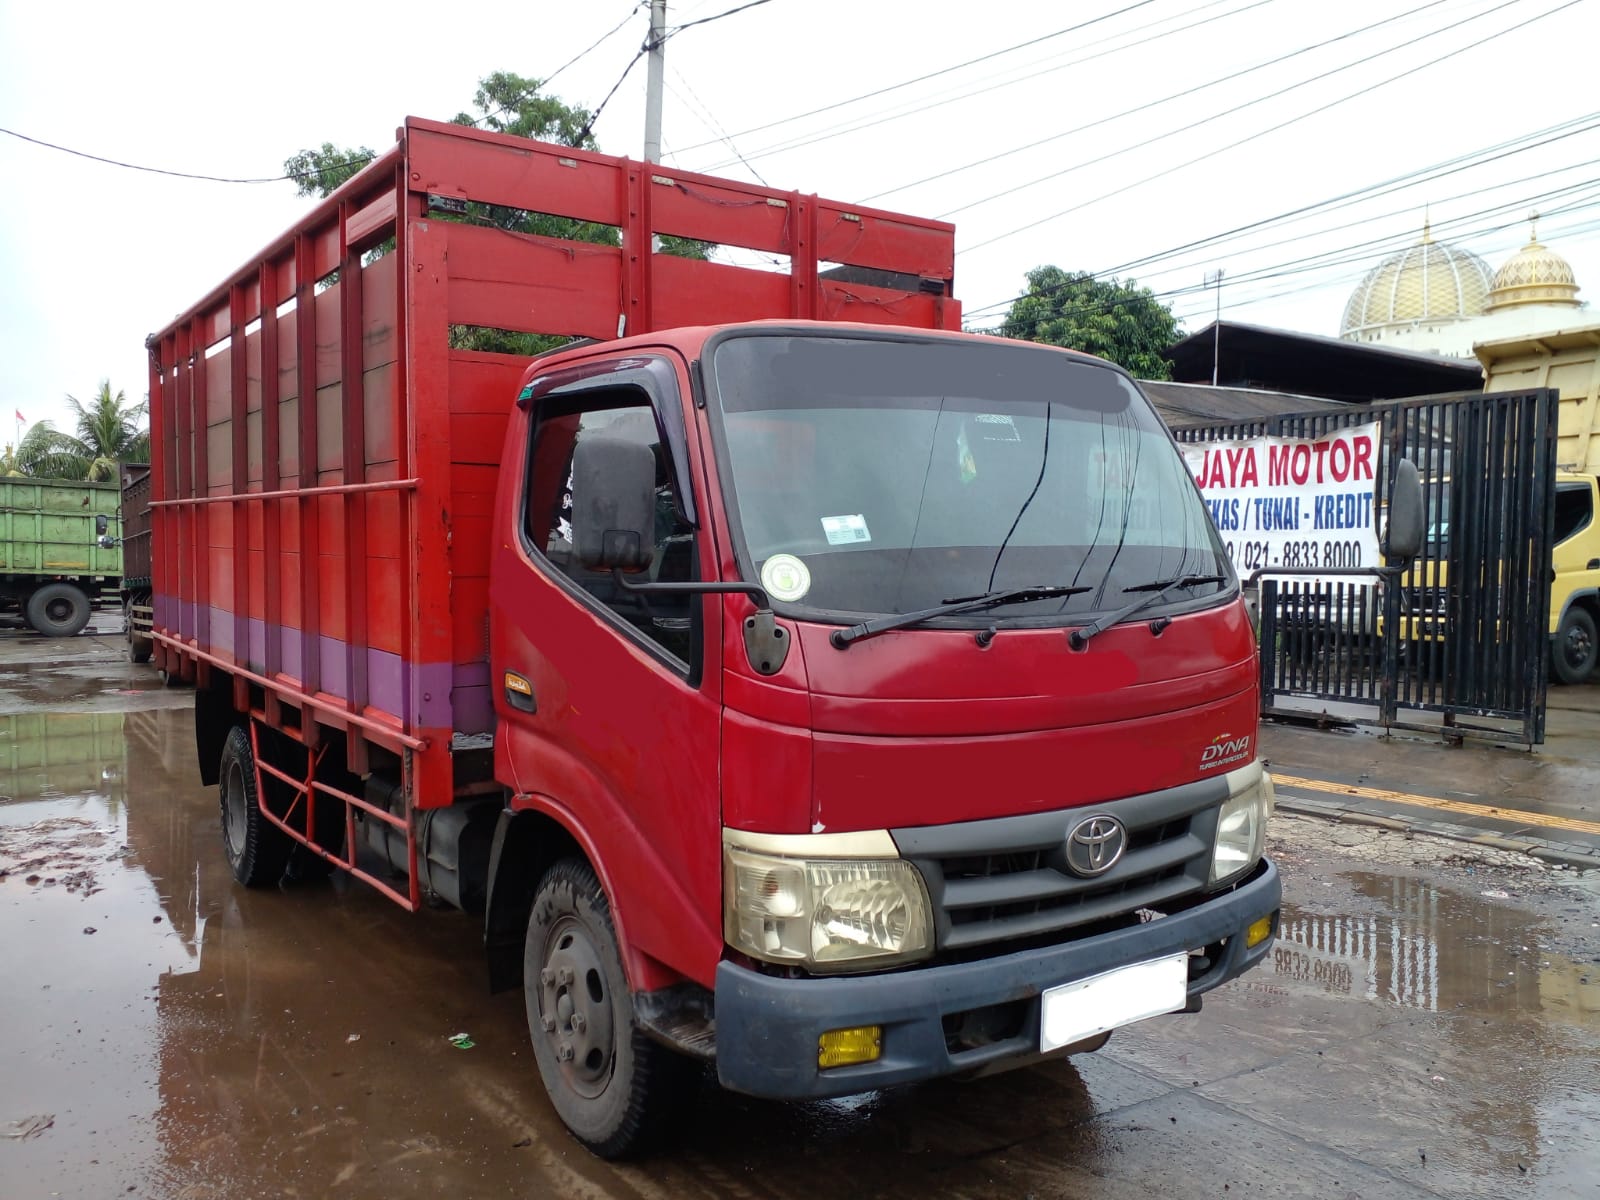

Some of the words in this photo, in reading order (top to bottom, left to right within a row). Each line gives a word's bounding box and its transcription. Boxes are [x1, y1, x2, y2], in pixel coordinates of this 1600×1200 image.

[1196, 446, 1259, 490] JAYA
[1268, 435, 1374, 487] MOTOR
[1243, 497, 1251, 531] /
[1254, 496, 1300, 531] TUNAI
[1314, 491, 1373, 530] KREDIT
[1245, 541, 1269, 571] 021
[1283, 541, 1319, 568] 8833
[1324, 540, 1362, 568] 8000
[1202, 736, 1249, 761] DYNA
